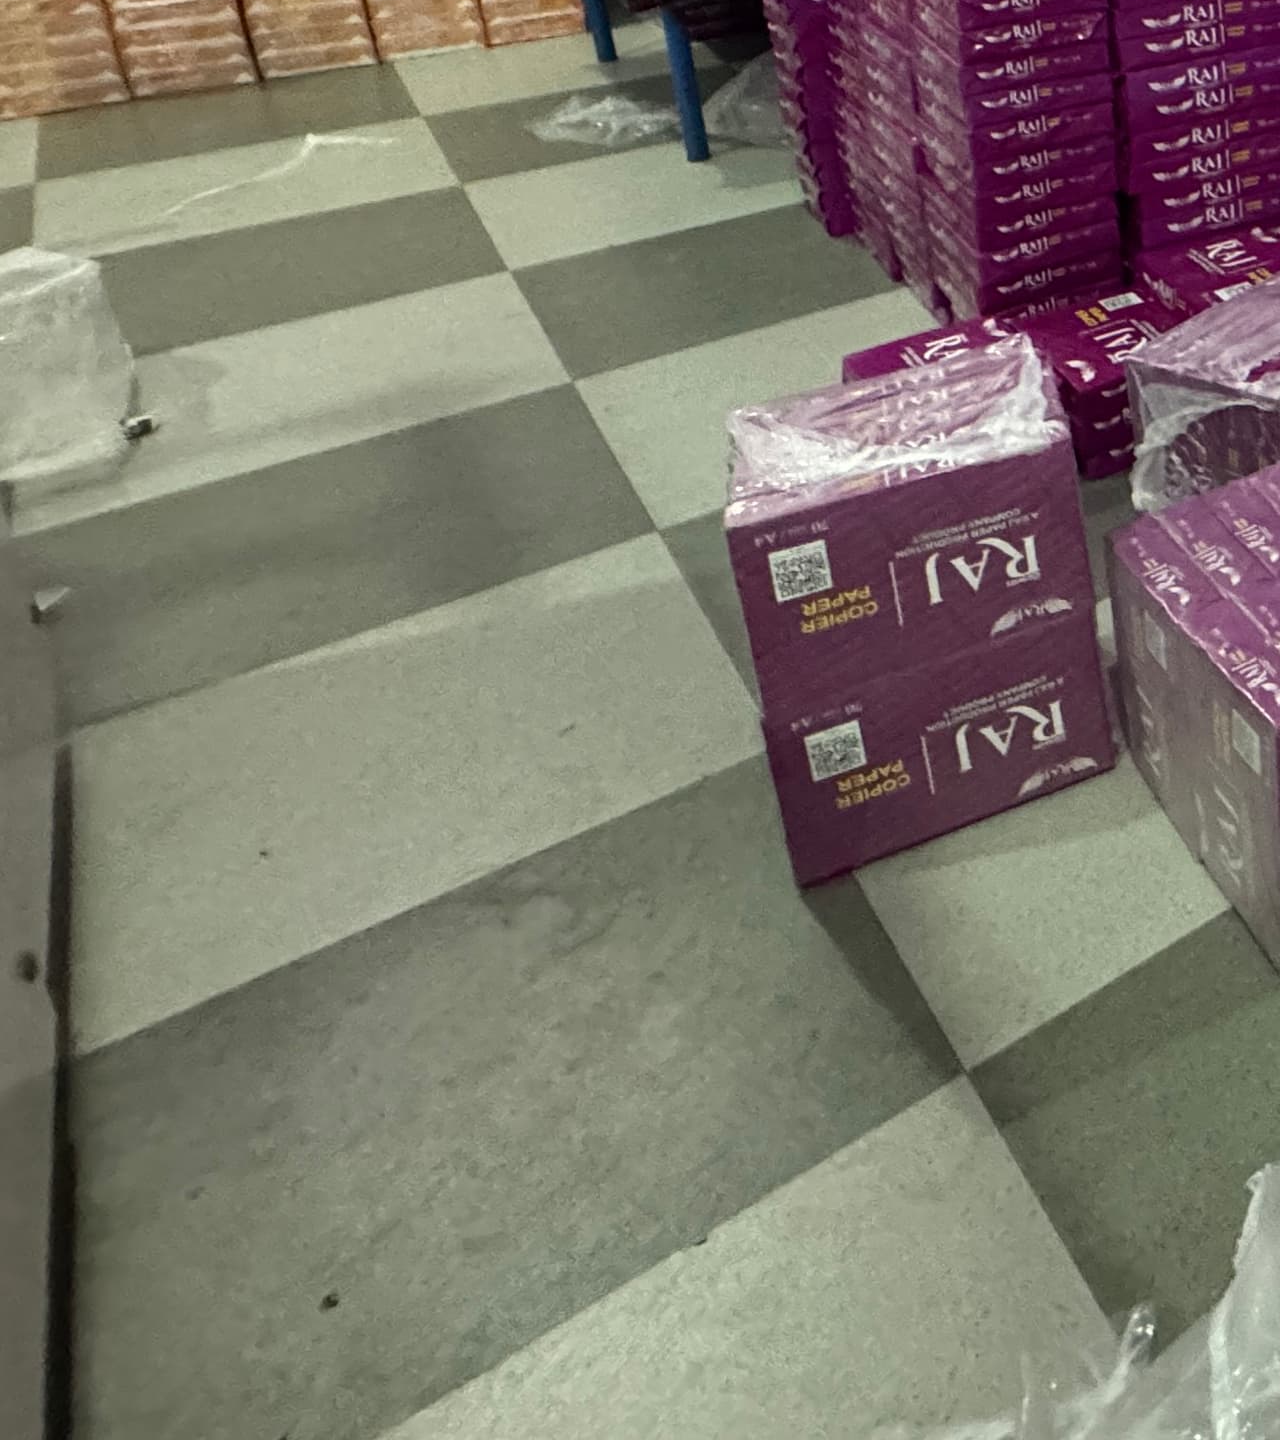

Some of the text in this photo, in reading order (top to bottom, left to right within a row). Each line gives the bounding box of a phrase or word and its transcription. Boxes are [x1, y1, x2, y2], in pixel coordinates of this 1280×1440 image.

[1184, 4, 1214, 20] RAJ
[1188, 66, 1218, 82] RAJ
[1192, 155, 1222, 173] RAJ
[926, 535, 1040, 605] RAJ
[804, 586, 872, 616] PAPER
[802, 603, 879, 634] COPIER
[955, 701, 1066, 773] RAJ
[836, 774, 911, 808] COPIER
[838, 760, 904, 792] PAPER
